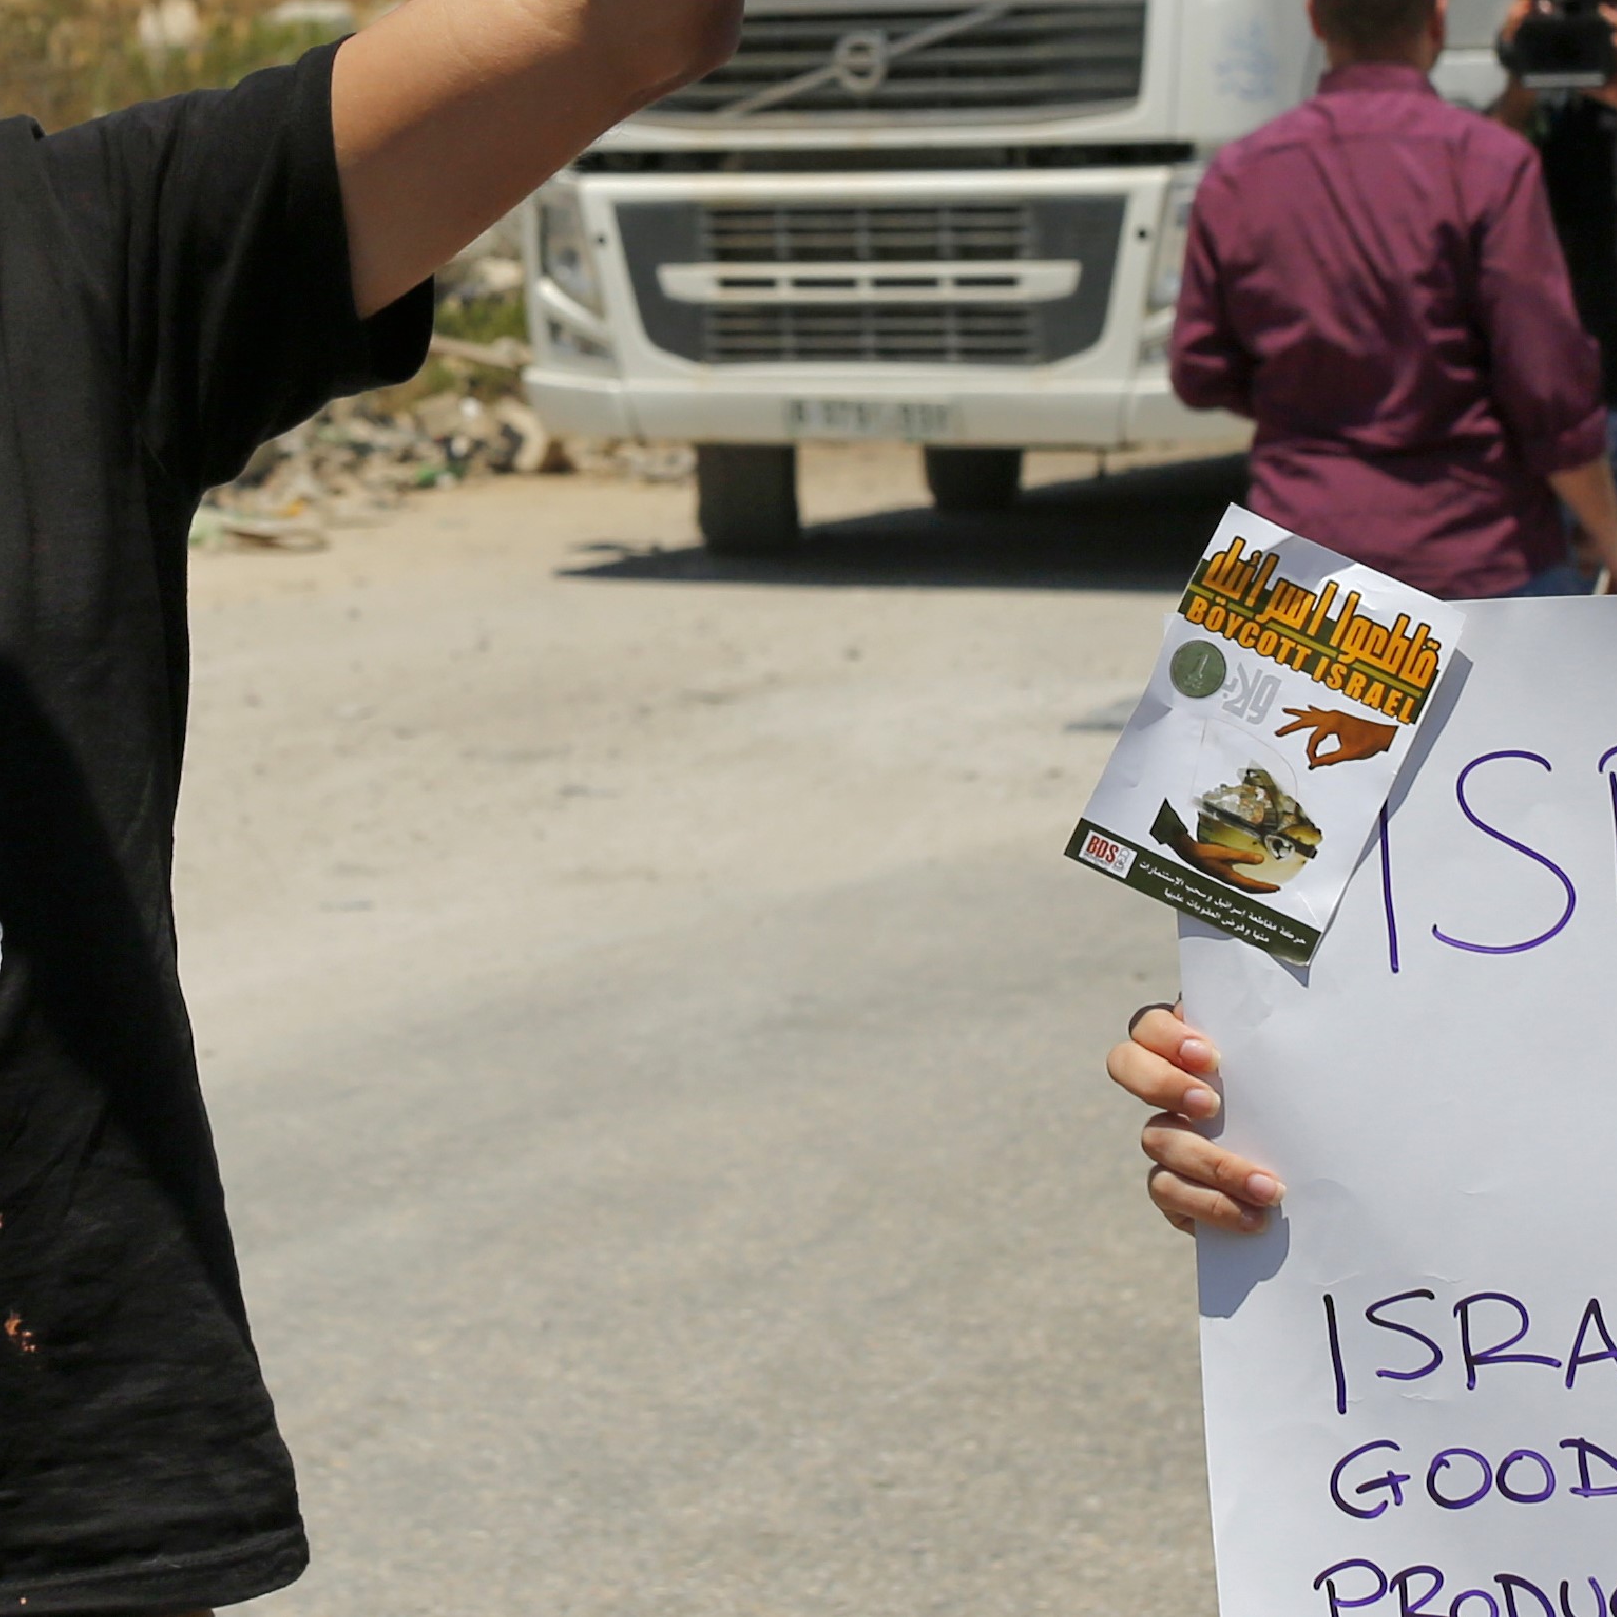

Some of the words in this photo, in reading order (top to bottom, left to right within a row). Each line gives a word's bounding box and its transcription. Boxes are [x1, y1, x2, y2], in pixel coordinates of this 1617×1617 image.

[1185, 595, 1313, 673] BOYCOTT
[1312, 655, 1415, 725] ISRAEL
[1329, 590, 1441, 689] قاطعوا
[1086, 834, 1119, 864] BDS
